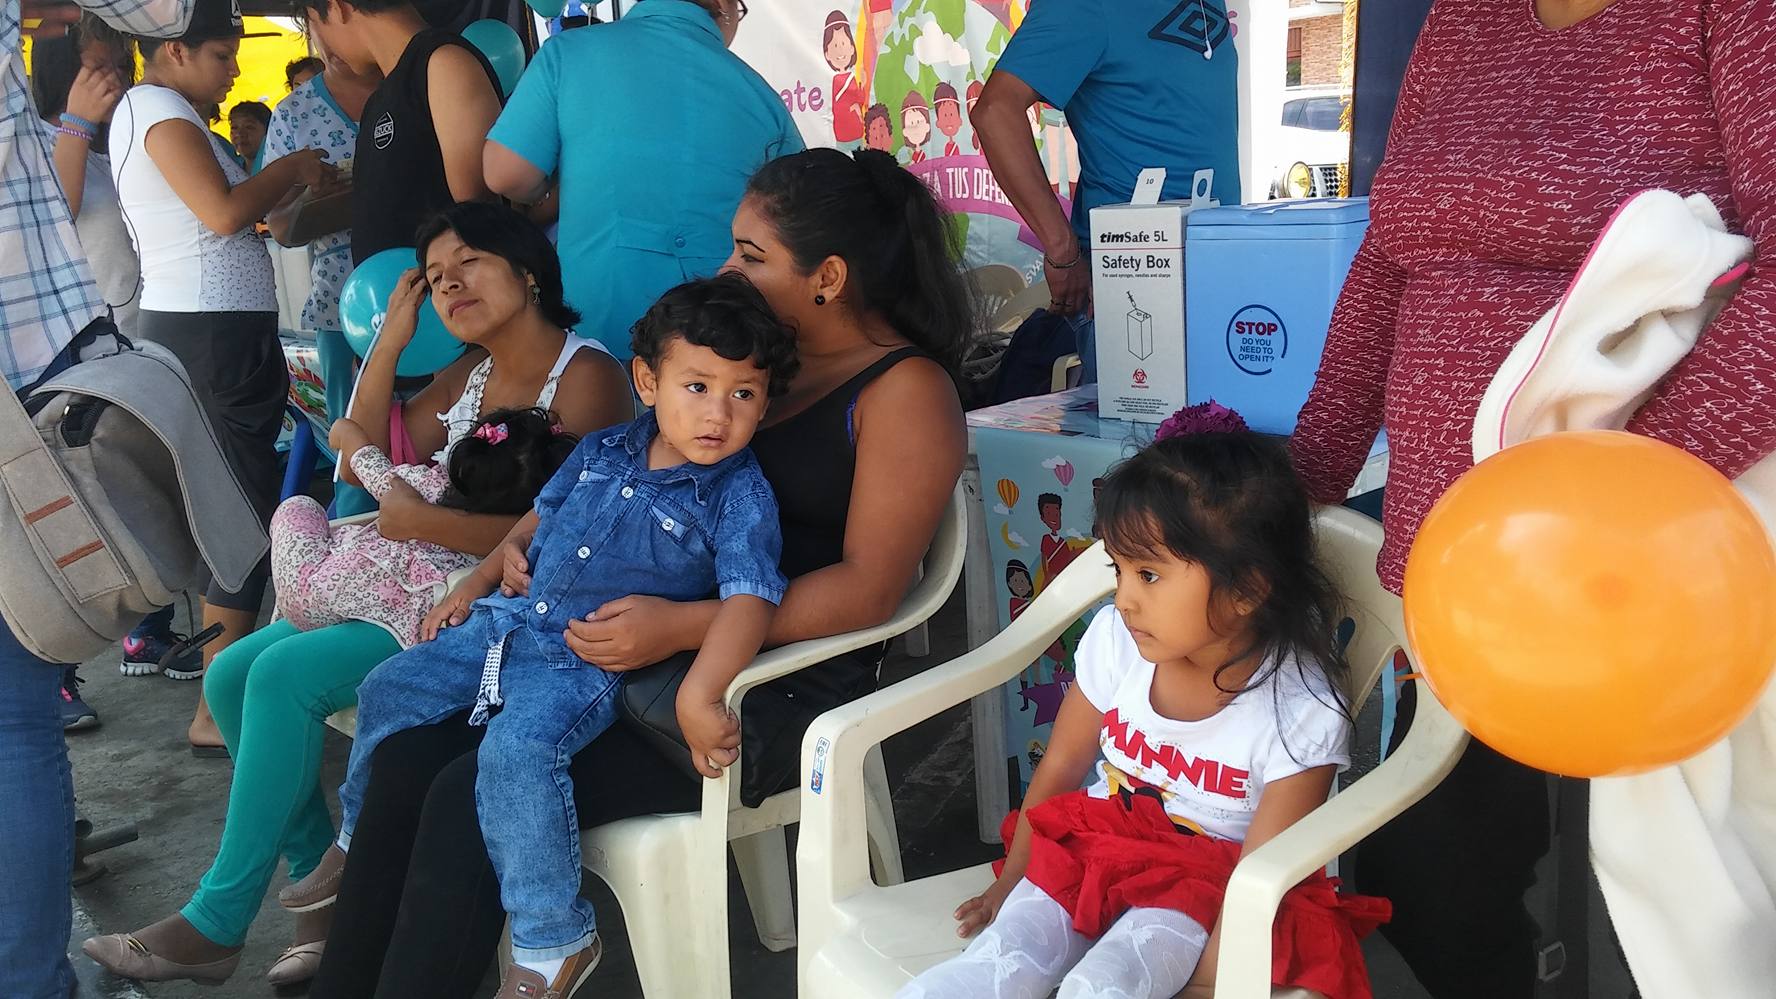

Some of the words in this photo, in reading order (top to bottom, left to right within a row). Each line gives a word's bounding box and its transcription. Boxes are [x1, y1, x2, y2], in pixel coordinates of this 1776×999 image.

[780, 79, 824, 112] ate
[946, 167, 970, 199] TUS
[1100, 231, 1150, 243] timSafe
[1153, 230, 1169, 242] 5L
[1102, 254, 1142, 272] Safety
[1146, 254, 1171, 269] Box
[1235, 321, 1278, 336] STOP
[1242, 337, 1254, 345] DO
[1255, 338, 1271, 347] YOU
[1238, 353, 1261, 361] OPEN
[1240, 346, 1261, 354] NEED
[1262, 347, 1274, 355] TO
[1102, 707, 1249, 799] MINNIE
